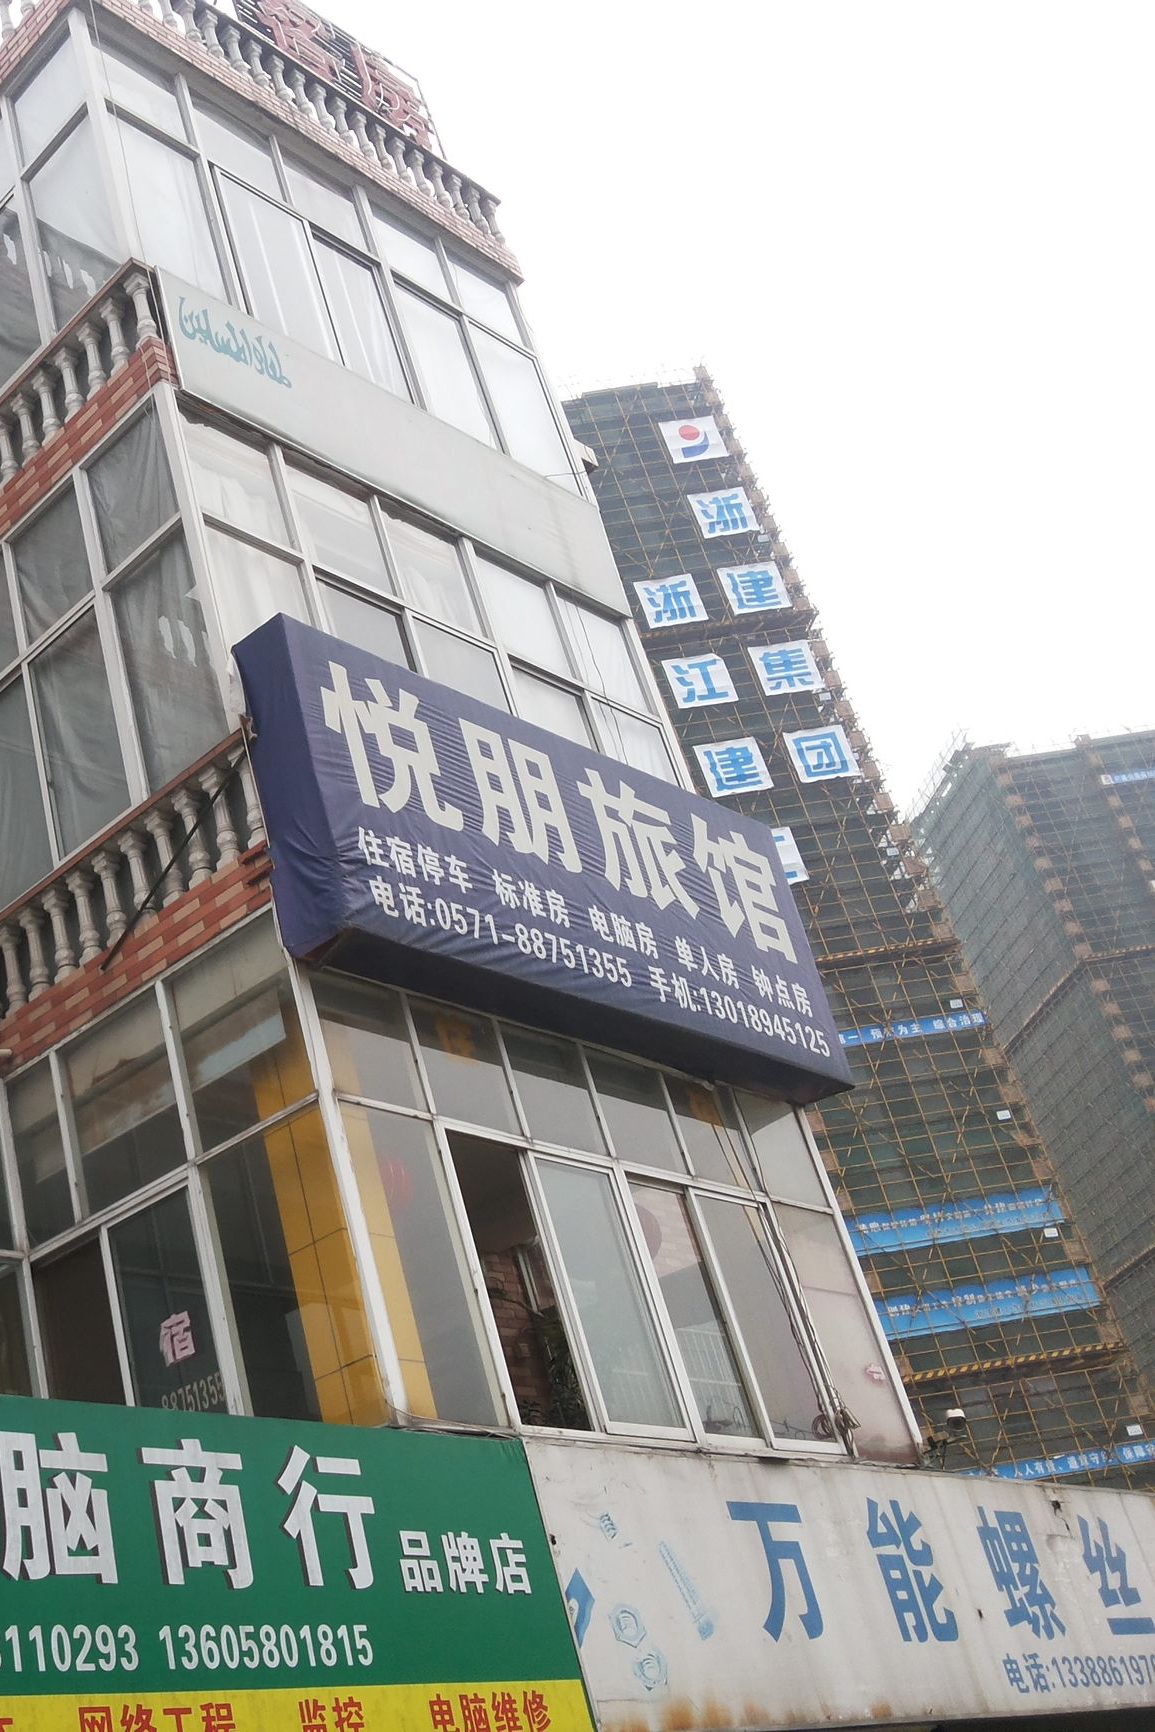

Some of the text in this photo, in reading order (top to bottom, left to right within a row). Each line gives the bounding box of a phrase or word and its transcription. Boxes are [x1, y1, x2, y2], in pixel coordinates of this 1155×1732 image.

[699, 491, 850, 777] 浙建集团
[321, 660, 799, 965] 悦朋旅馆
[357, 826, 814, 1018] 住宿停车 标准房 电脑房 单人房 钟点房
[159, 1310, 196, 1367] 宿
[399, 1530, 533, 1596] 品牌店
[726, 1496, 1155, 1643] 万能螺丝
[159, 1623, 375, 1672] 13605801815
[297, 1697, 365, 1732] 监控
[428, 1690, 552, 1732] 电脑维修
